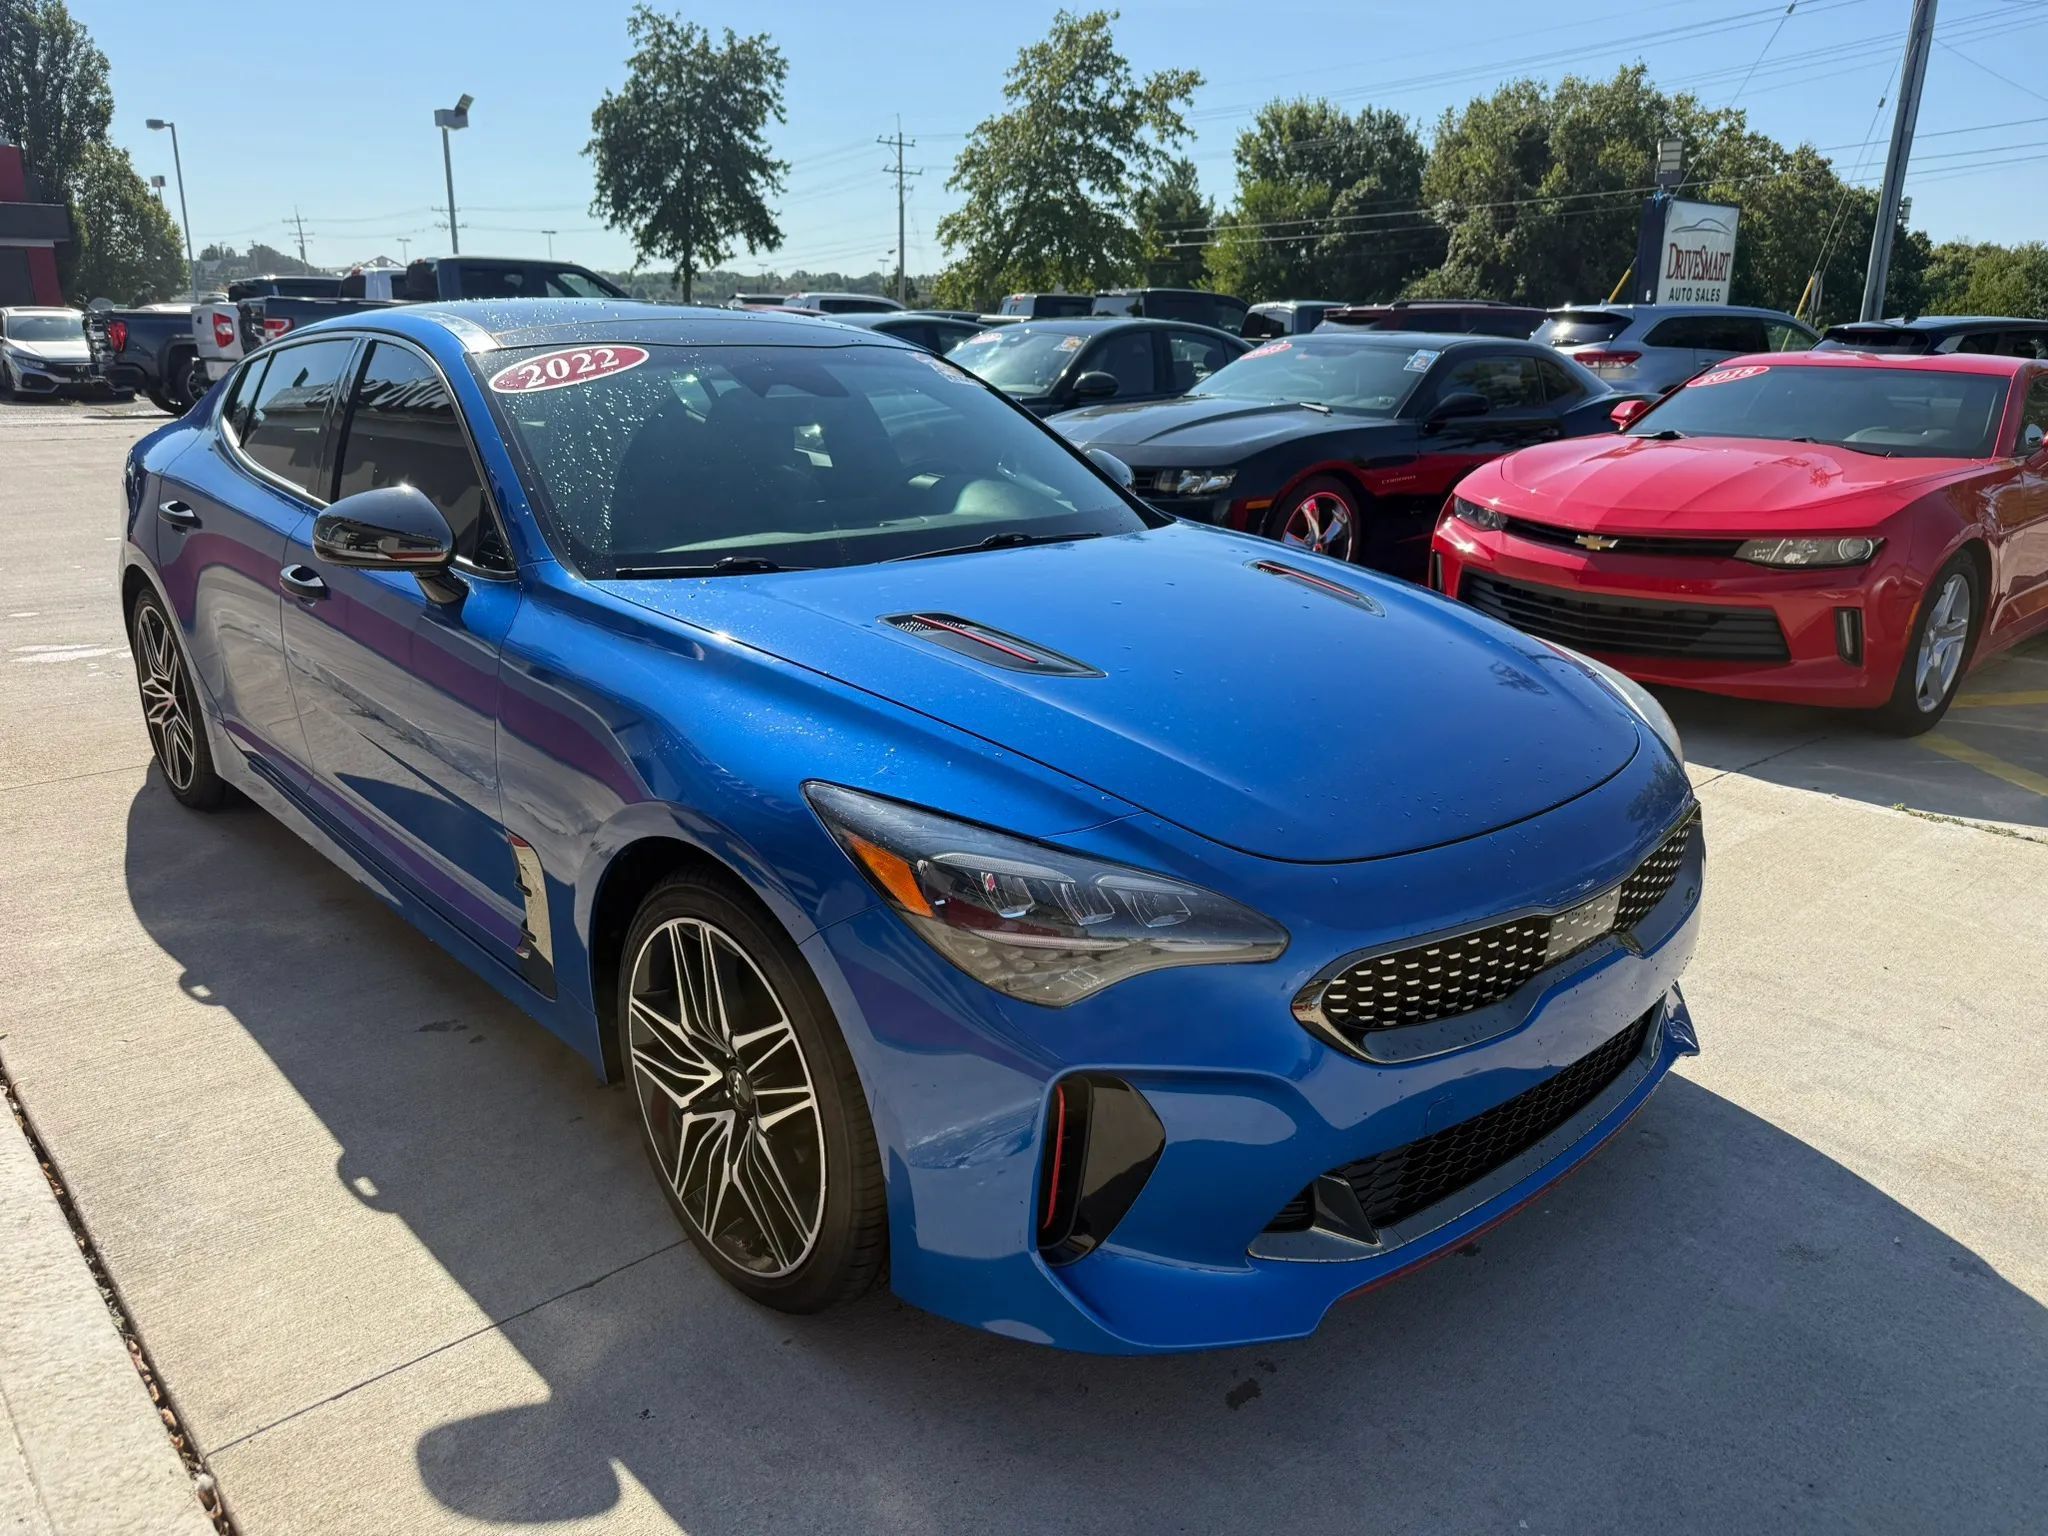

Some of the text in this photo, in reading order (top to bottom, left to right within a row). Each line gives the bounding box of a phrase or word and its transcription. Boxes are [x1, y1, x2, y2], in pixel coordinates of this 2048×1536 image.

[1668, 287, 1721, 302] AUTO SALES
[518, 348, 620, 389] 2022
